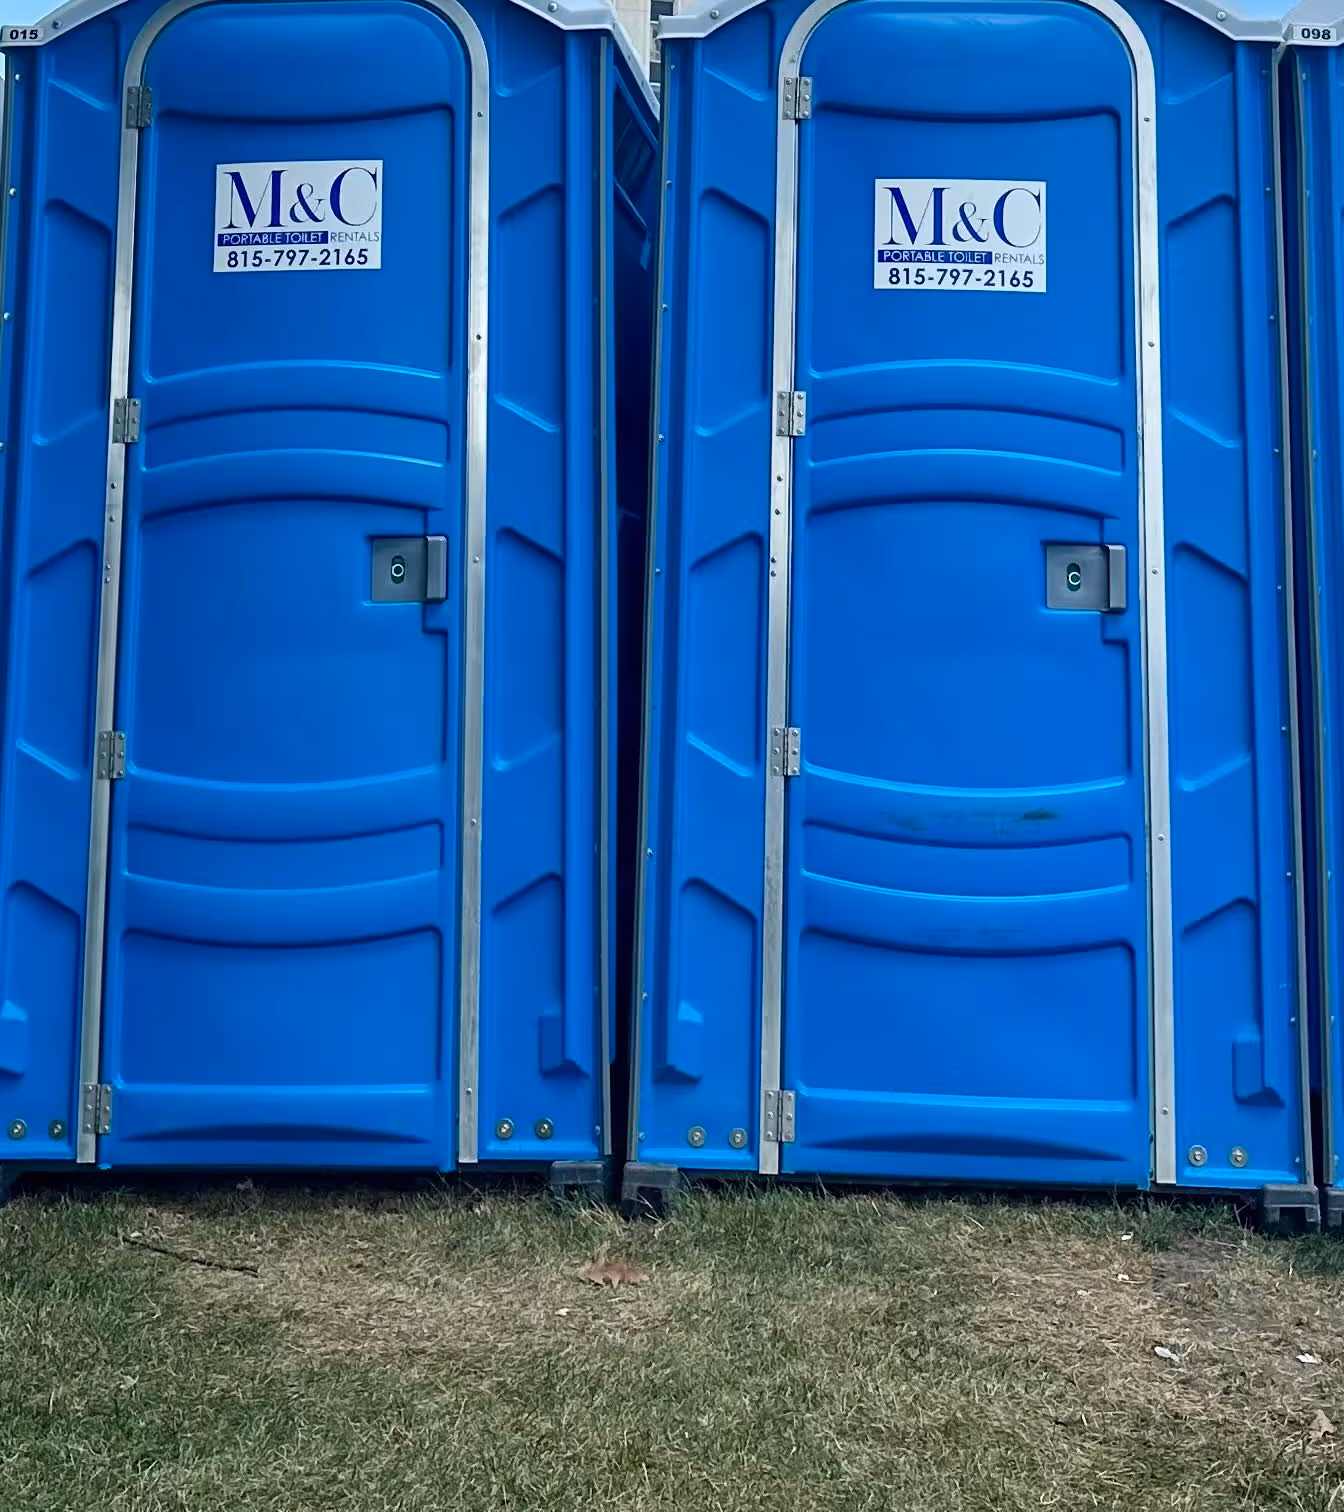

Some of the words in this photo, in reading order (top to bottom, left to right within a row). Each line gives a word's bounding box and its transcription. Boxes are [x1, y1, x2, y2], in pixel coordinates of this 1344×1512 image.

[9, 29, 39, 40] 015
[1301, 28, 1331, 40] 098
[222, 167, 378, 230] M&C
[882, 187, 1042, 248] M&C
[223, 234, 282, 245] PORTABLE
[284, 232, 324, 244] TOILET
[330, 231, 380, 243] RENTALS
[227, 249, 369, 268] 815-797-2165
[883, 250, 945, 262] PORTABLE
[949, 251, 987, 263] TOILET
[994, 253, 1045, 265] RENTALS
[888, 267, 1034, 288] 815-797-2165
